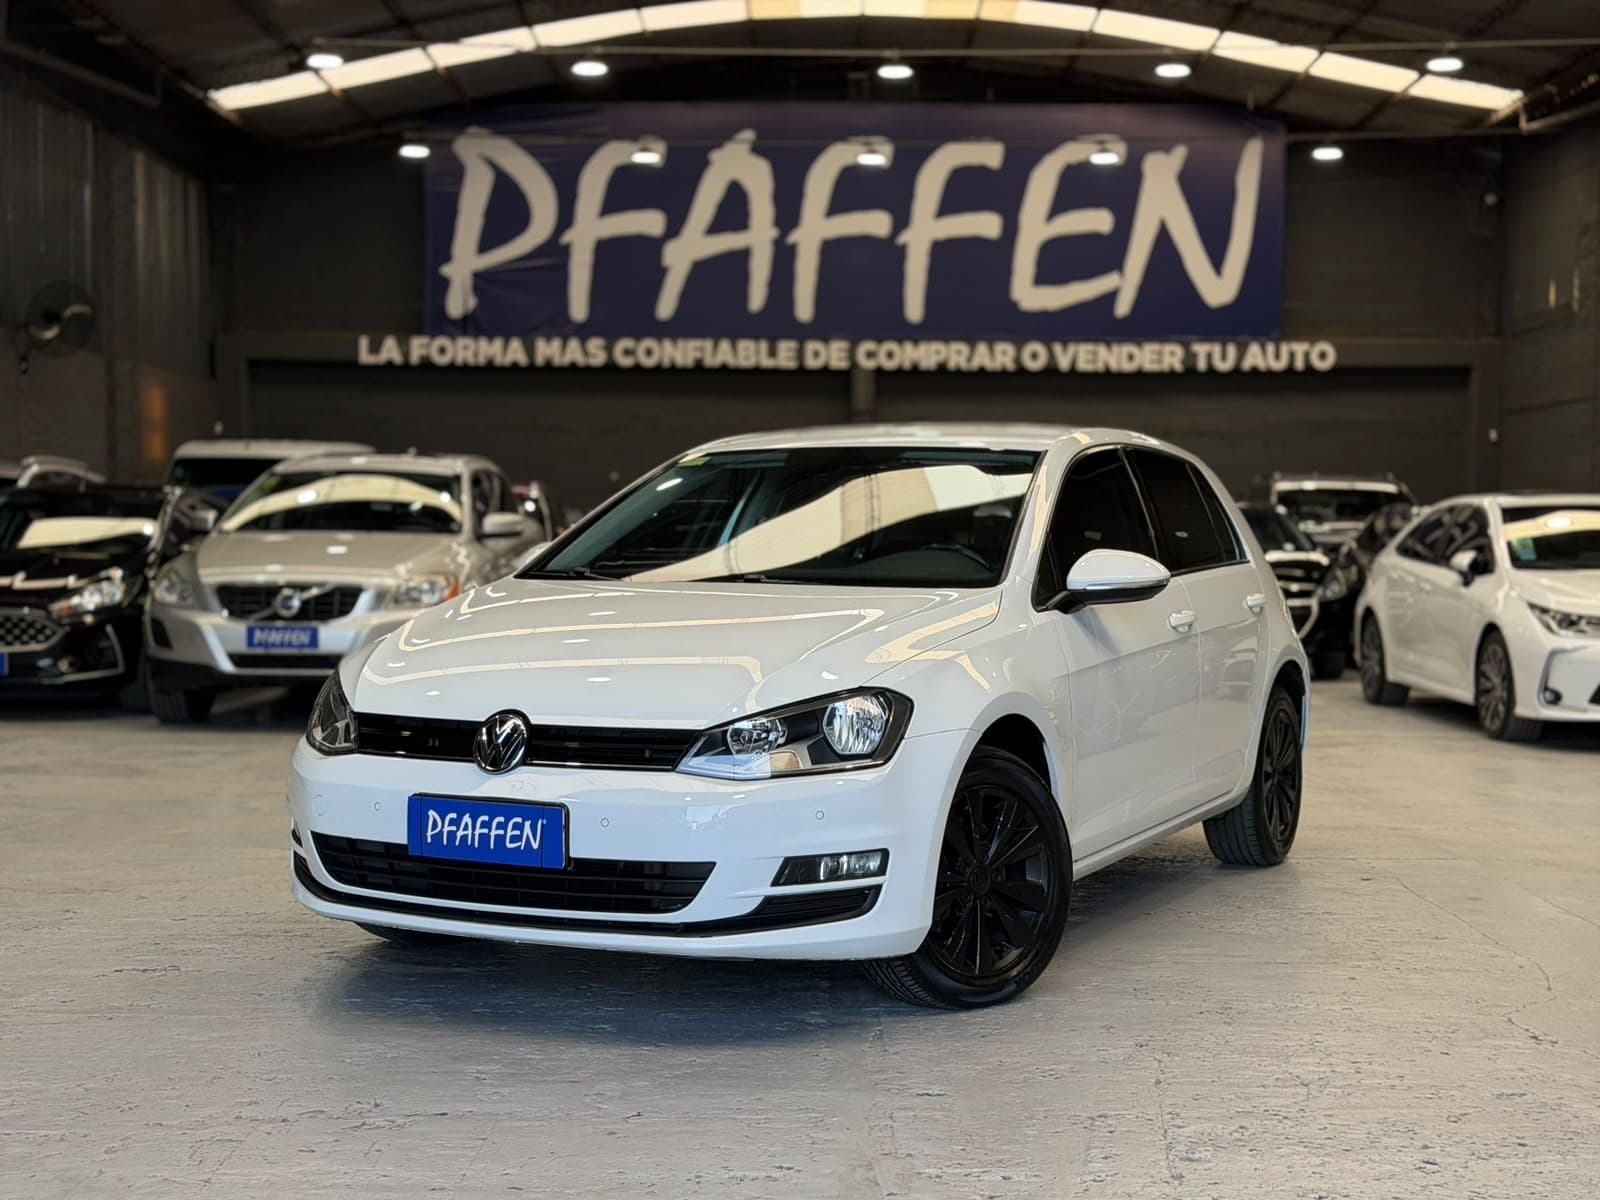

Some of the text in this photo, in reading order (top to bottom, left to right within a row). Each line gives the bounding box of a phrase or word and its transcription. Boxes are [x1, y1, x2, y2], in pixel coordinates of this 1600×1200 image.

[439, 126, 1263, 325] PFAFFEN
[357, 334, 1337, 373] LA FORMA MAS CONFIABLE DE COMPRAR O VENDER TU AUTO
[426, 808, 543, 851] PFAFFEN
